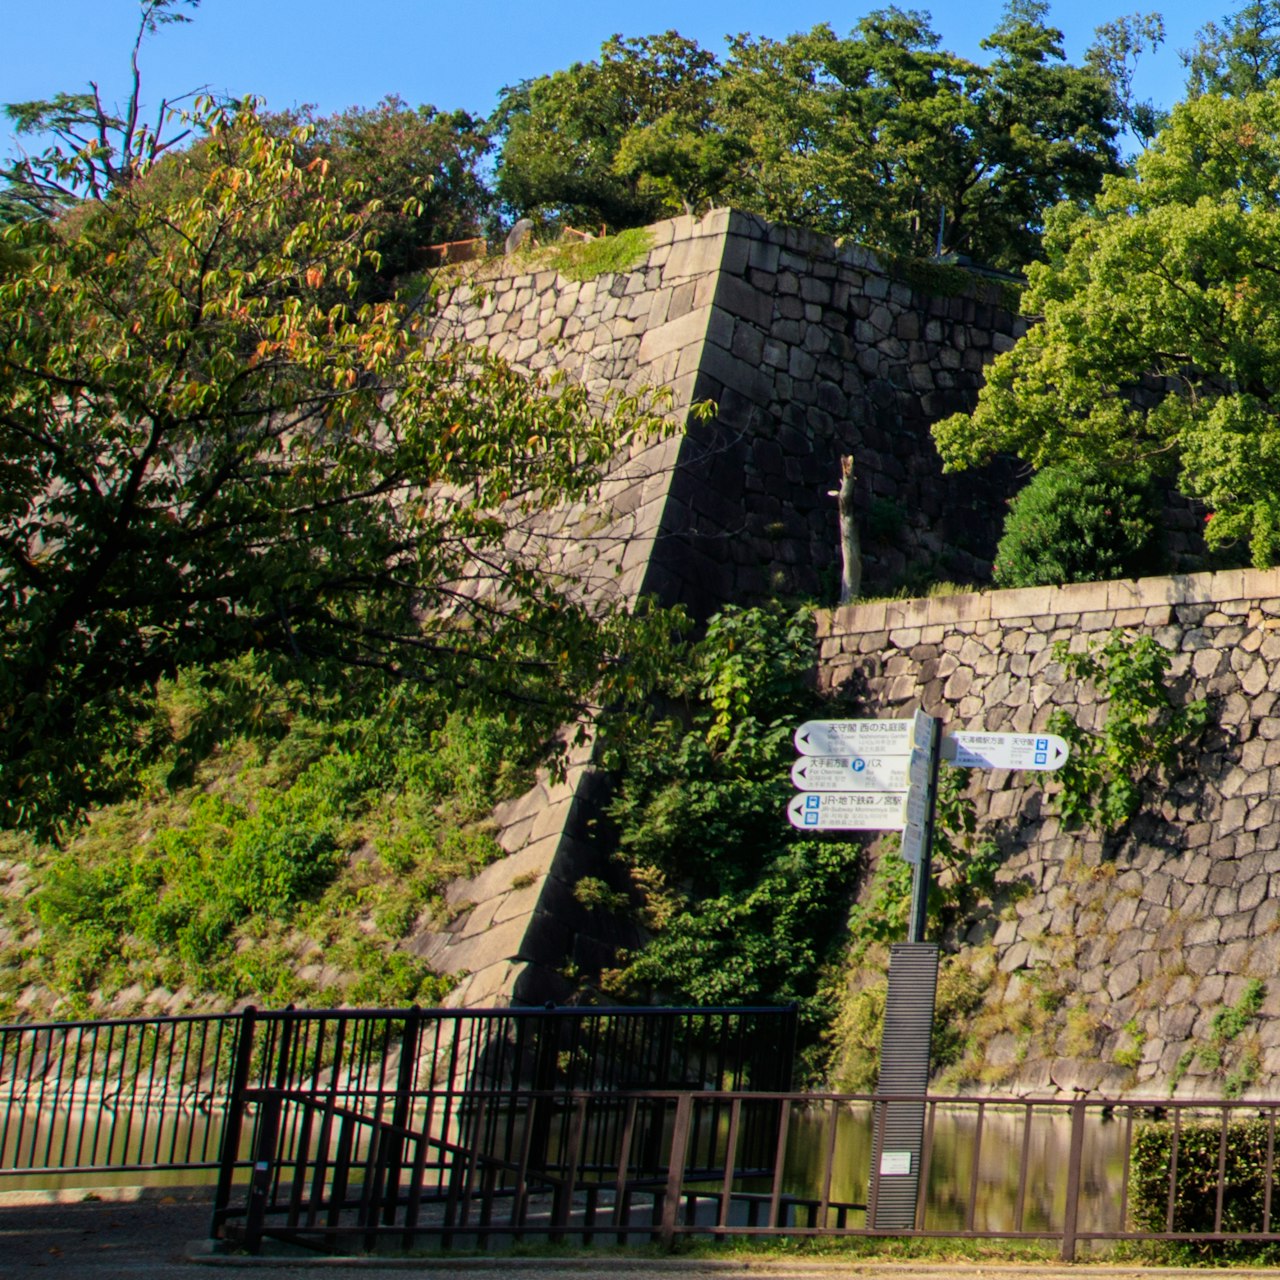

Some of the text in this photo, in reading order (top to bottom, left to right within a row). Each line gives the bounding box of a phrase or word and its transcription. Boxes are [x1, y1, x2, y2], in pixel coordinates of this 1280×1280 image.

[859, 723, 907, 733] 西の丸庭園
[867, 758, 882, 767] バス
